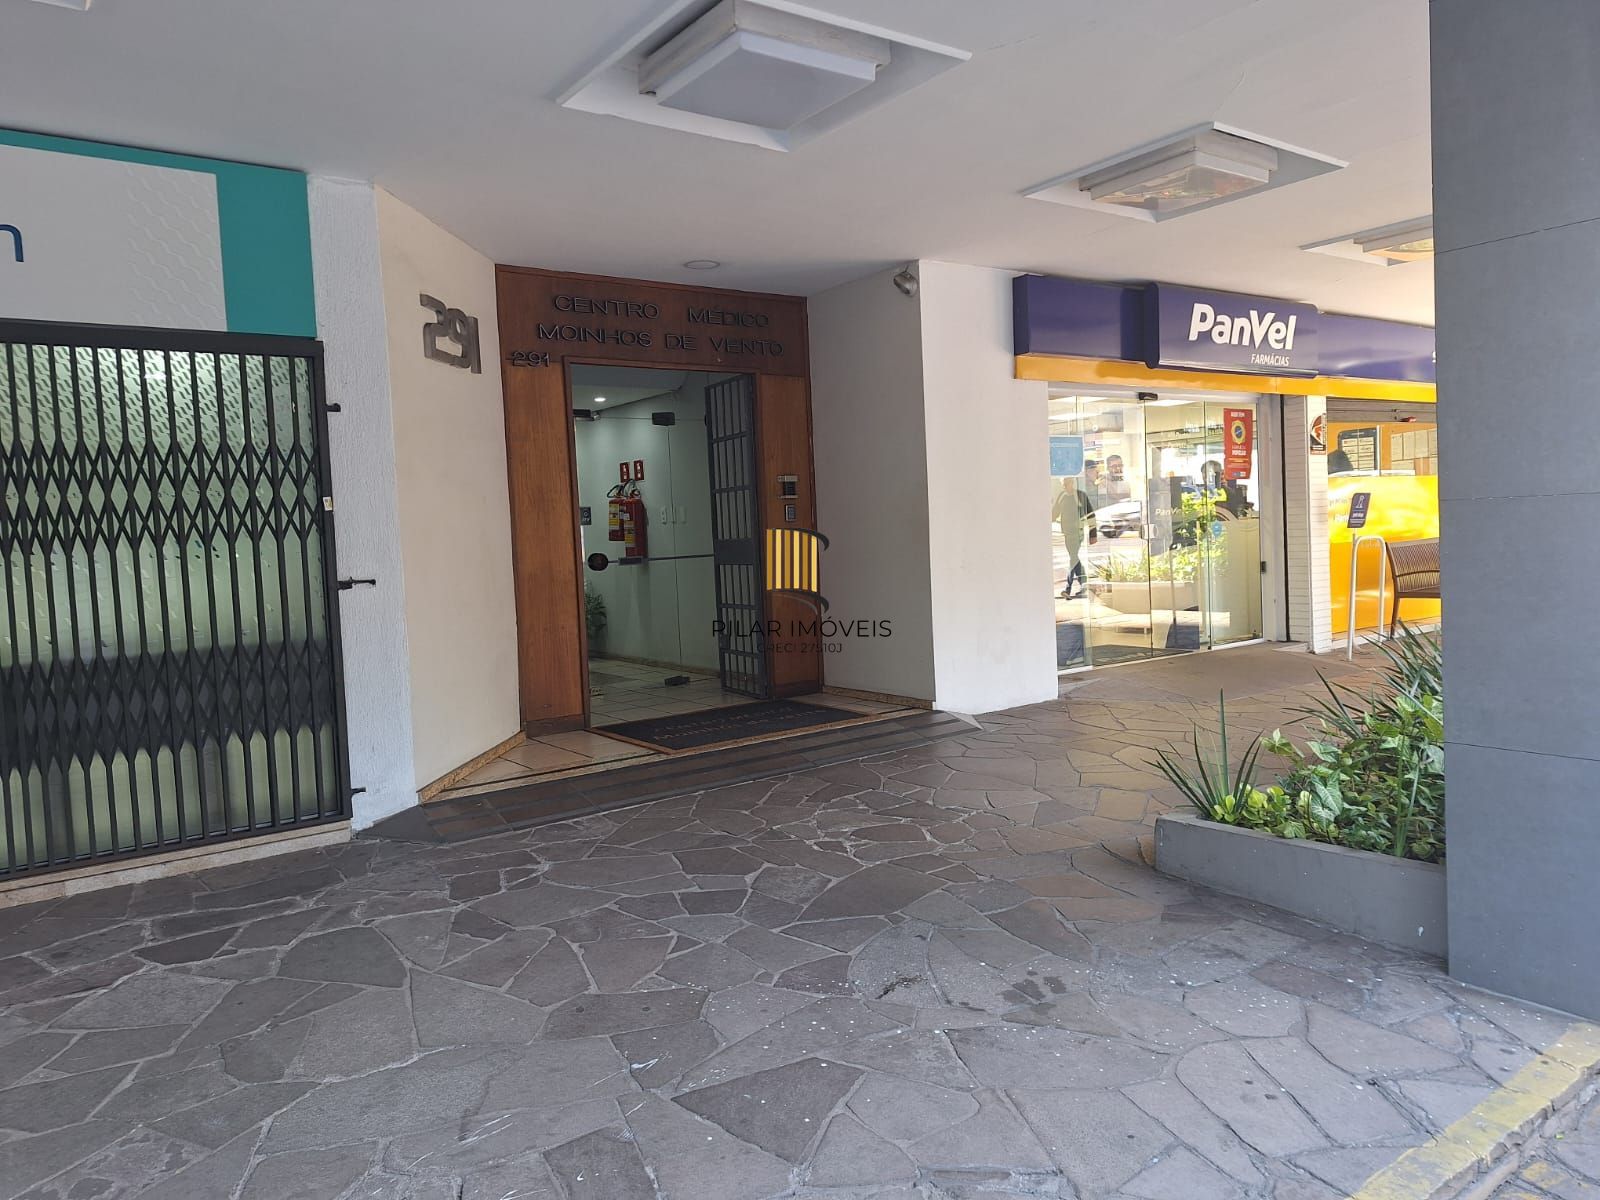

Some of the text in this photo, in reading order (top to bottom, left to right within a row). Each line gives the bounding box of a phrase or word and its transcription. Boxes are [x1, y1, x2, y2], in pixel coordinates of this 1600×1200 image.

[554, 295, 660, 320] CENTRO
[419, 293, 482, 374] 291
[537, 322, 784, 357] MOINHOS DE VENTO
[1188, 302, 1297, 350] PanVel
[512, 351, 550, 367] 291
[1250, 353, 1290, 367] FARMÁCIAS
